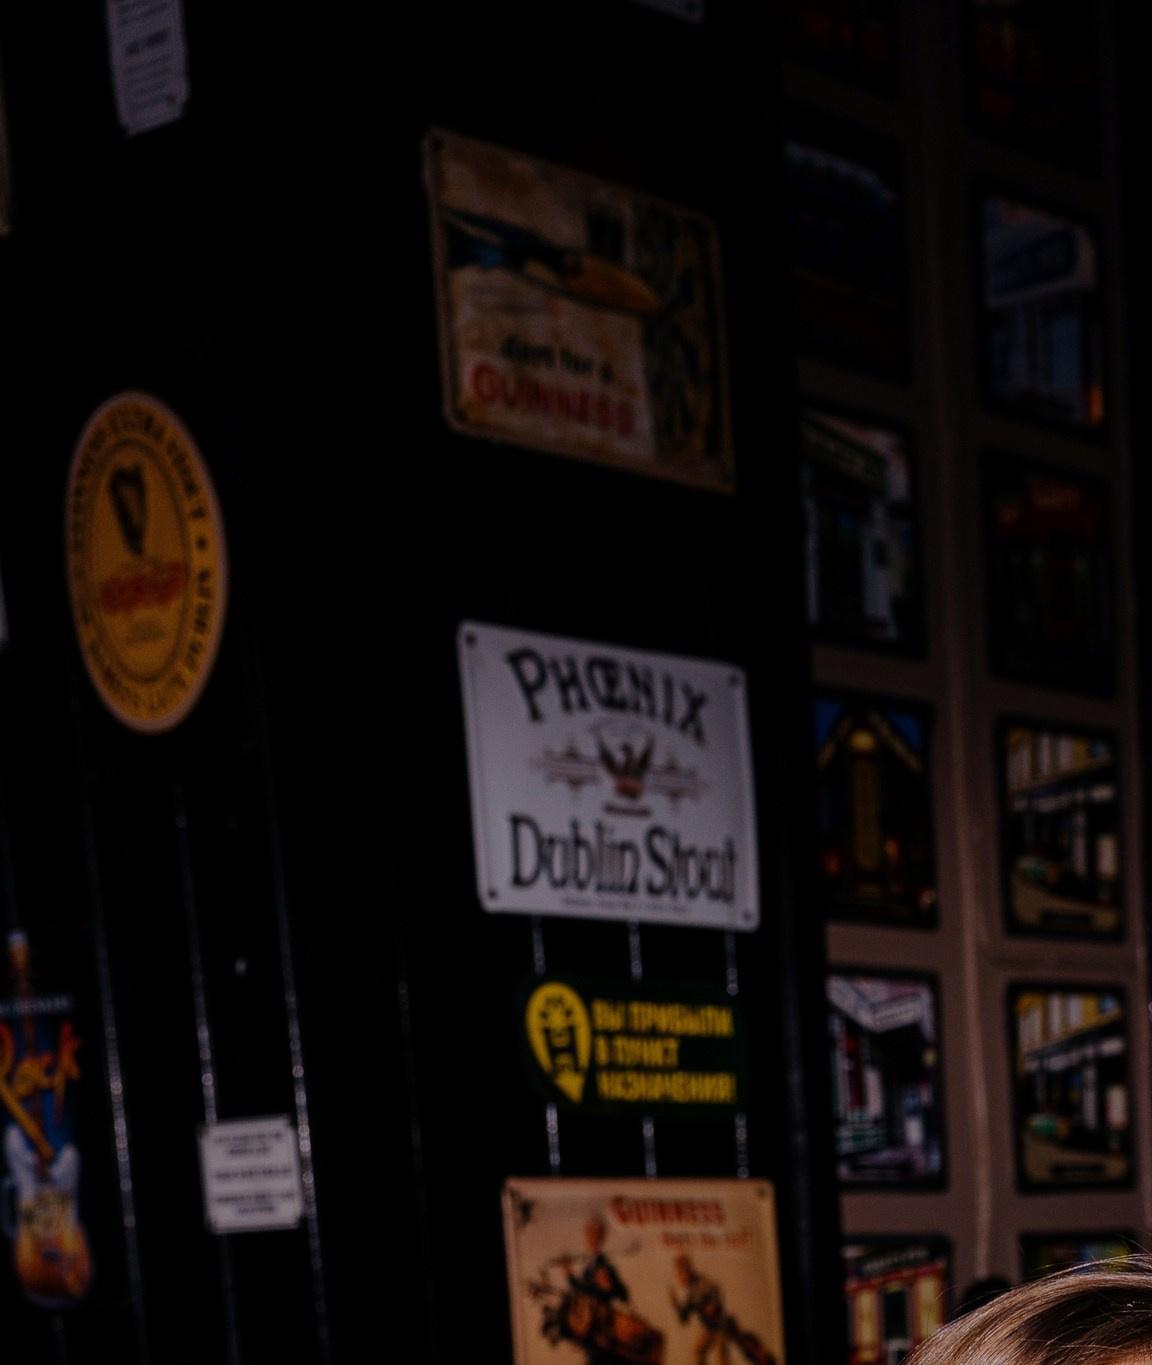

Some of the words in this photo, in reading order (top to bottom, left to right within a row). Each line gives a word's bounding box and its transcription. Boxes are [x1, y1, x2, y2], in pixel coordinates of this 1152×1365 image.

[508, 813, 641, 894] Dublin
[646, 825, 737, 903] Stout
[628, 999, 736, 1040] ПРИБЫЛИ
[612, 1034, 681, 1068] ПУНКТ
[596, 1070, 739, 1105] НАЗНАЧЕНИЯ
